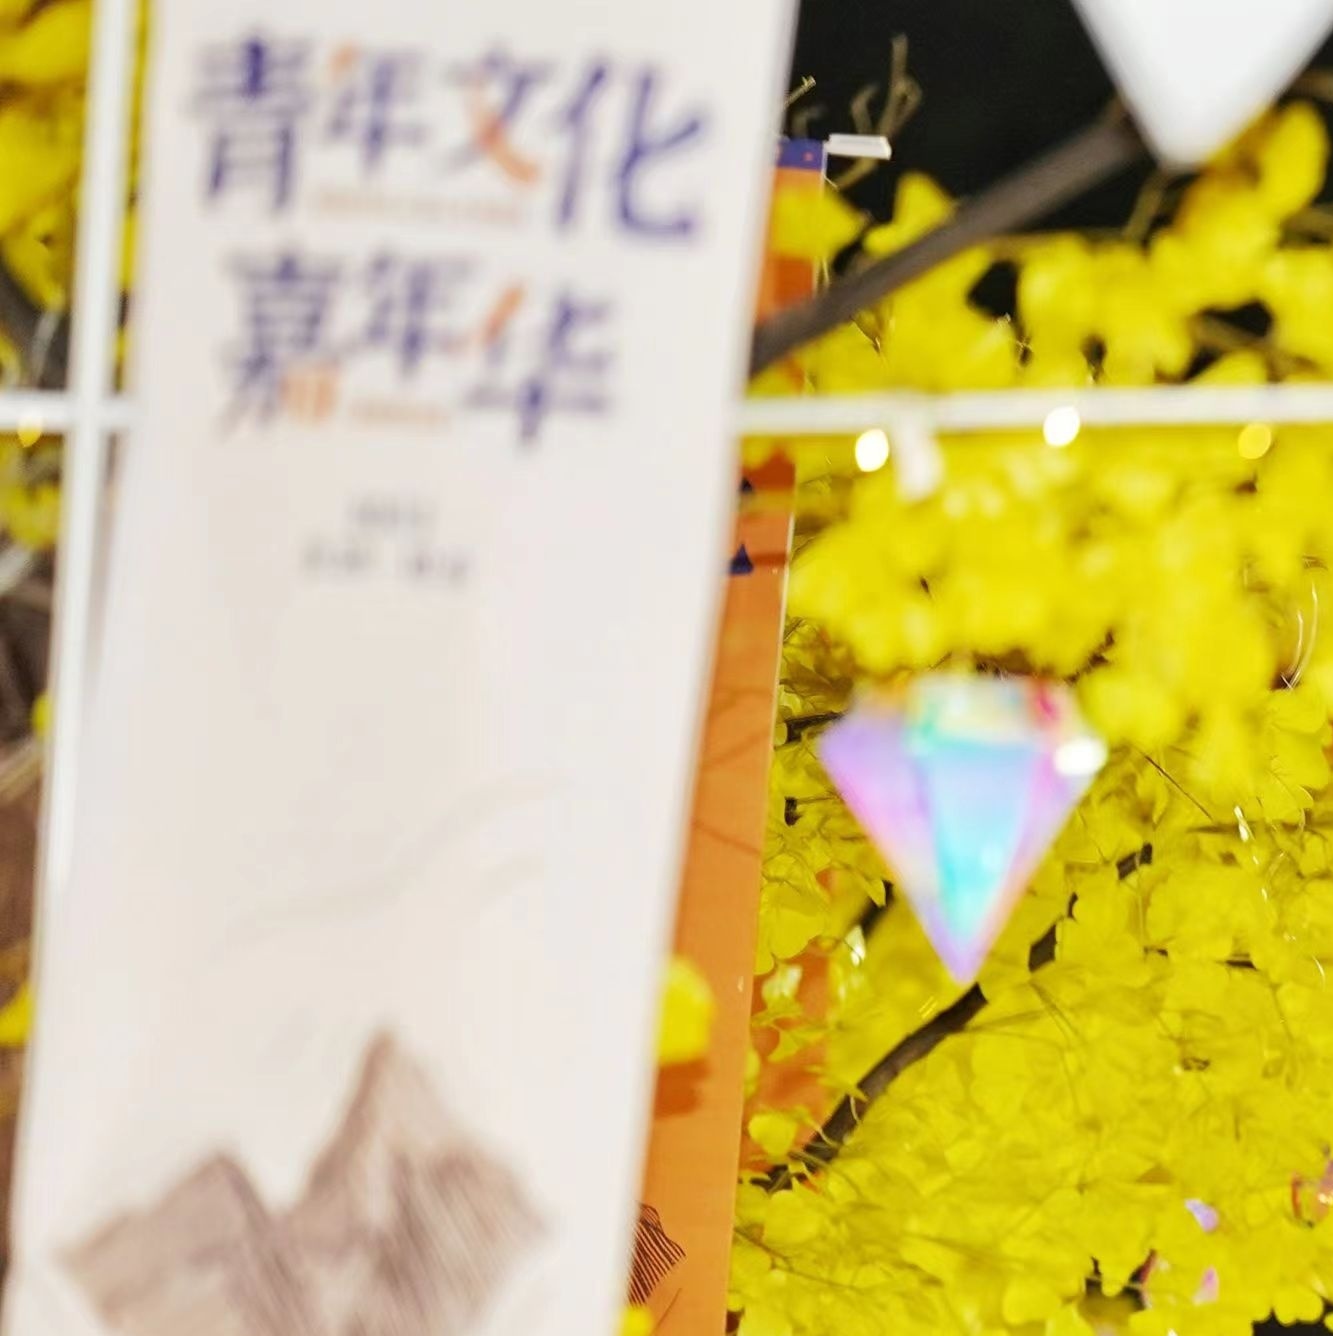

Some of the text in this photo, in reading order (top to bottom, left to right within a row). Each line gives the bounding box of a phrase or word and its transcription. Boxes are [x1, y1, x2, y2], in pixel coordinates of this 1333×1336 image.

[193, 33, 712, 243] 青年文化
[216, 252, 616, 447] 嘉年华
